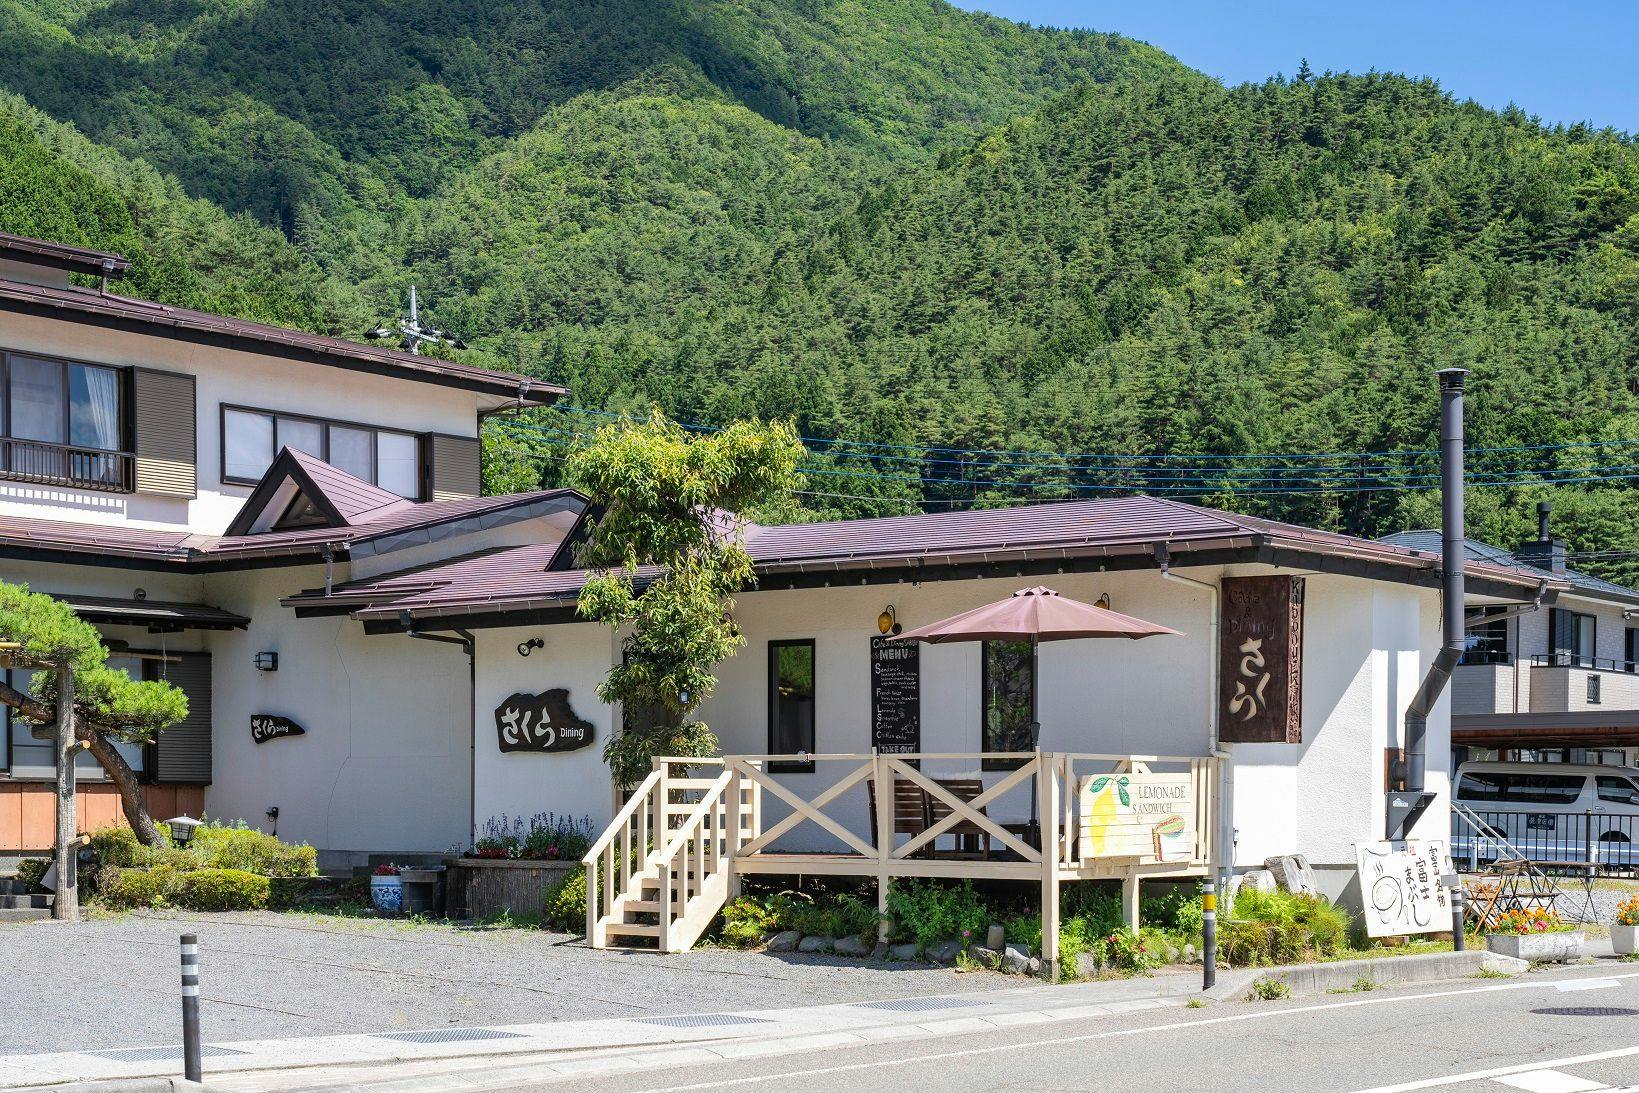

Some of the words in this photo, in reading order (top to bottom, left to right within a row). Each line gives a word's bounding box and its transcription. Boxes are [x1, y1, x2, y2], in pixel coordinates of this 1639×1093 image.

[879, 648, 909, 660] MENU
[1229, 637, 1271, 721] さくら
[252, 719, 276, 739] さくら
[501, 706, 556, 747] さくら
[560, 727, 585, 740] Dining
[881, 745, 899, 754] TAKE
[1138, 785, 1186, 799] LEMONADE
